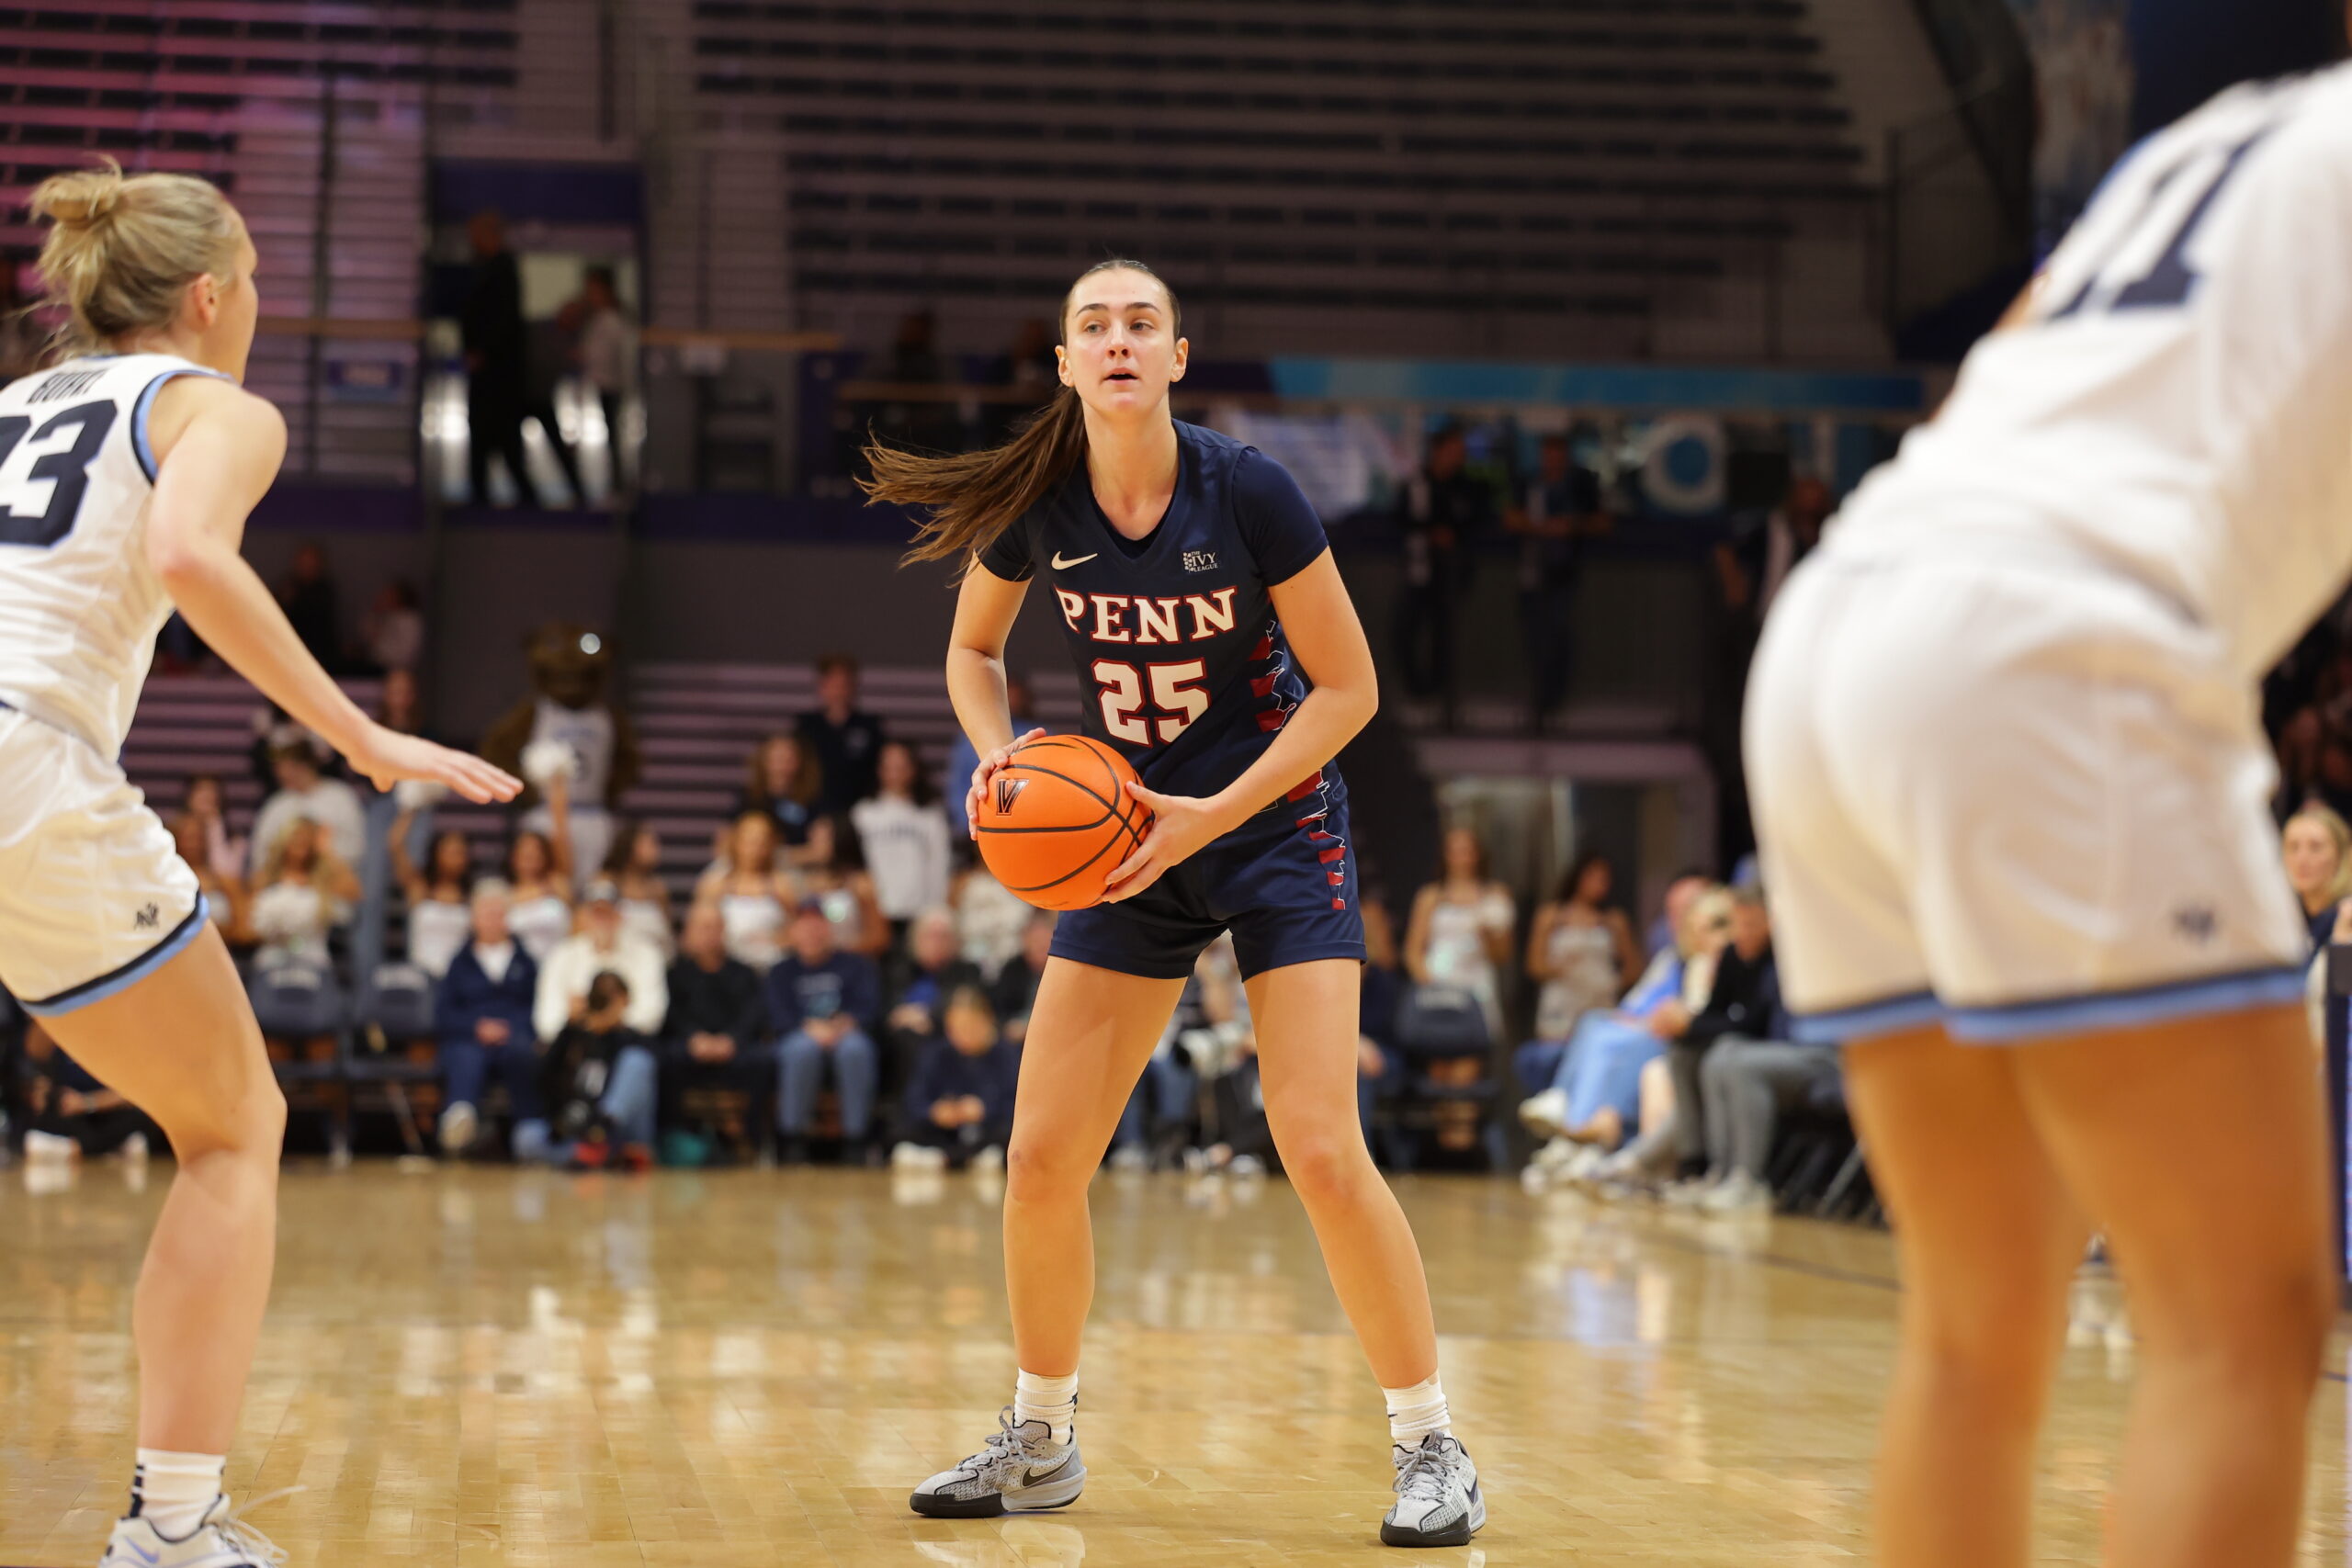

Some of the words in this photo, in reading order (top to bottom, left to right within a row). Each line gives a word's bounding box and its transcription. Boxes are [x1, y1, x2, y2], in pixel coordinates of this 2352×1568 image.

[1192, 552, 1216, 567] IVY
[1194, 563, 1218, 572] LEAGUE
[1053, 584, 1238, 645] PENN
[1091, 657, 1211, 748] 25
